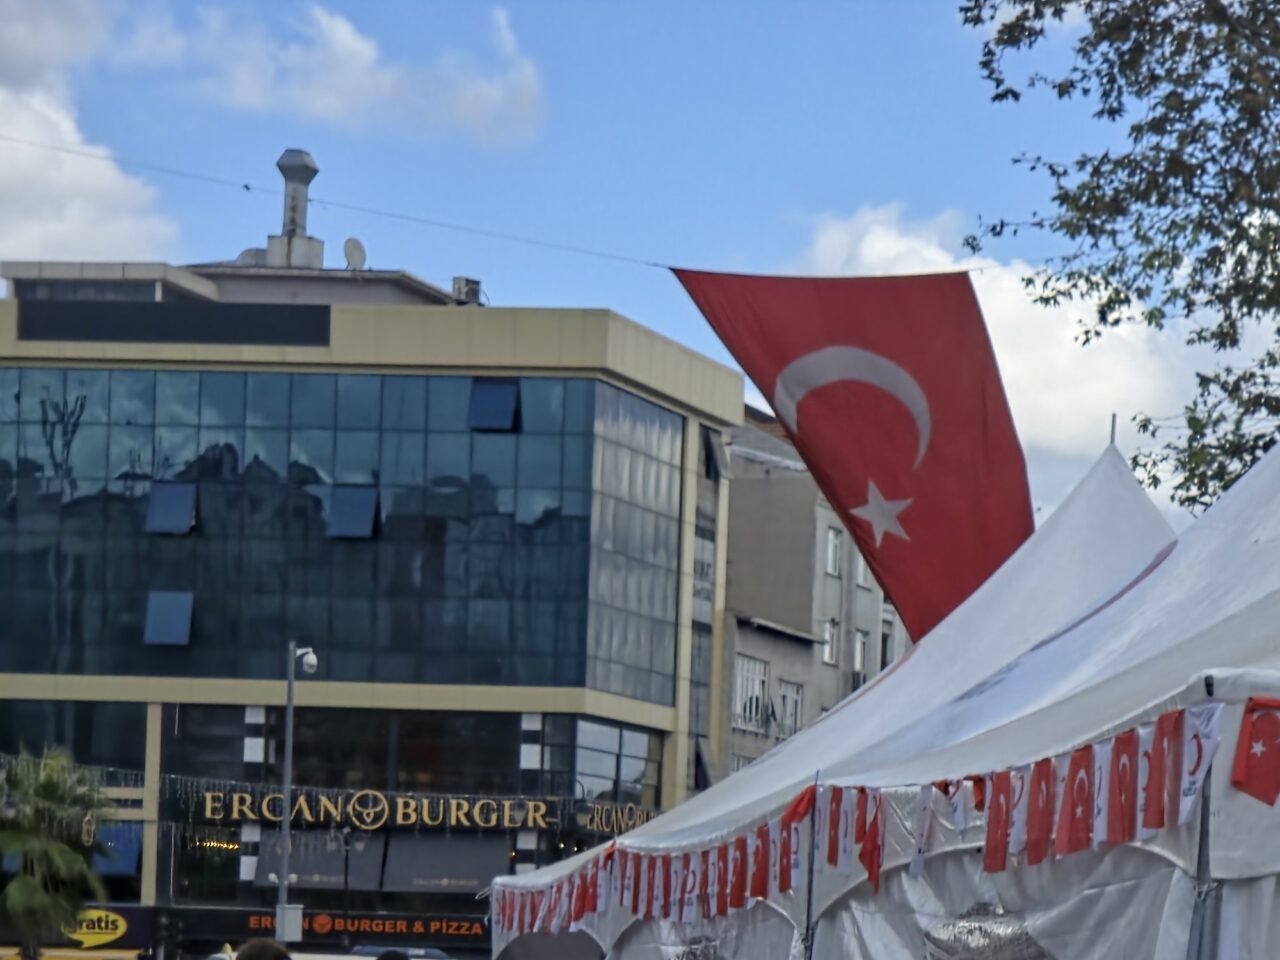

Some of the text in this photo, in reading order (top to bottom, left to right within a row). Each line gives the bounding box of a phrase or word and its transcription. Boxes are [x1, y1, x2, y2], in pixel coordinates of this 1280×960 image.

[204, 792, 548, 828] ERCAN BURGER
[249, 915, 483, 935] ERN BURGER & PİZZA
